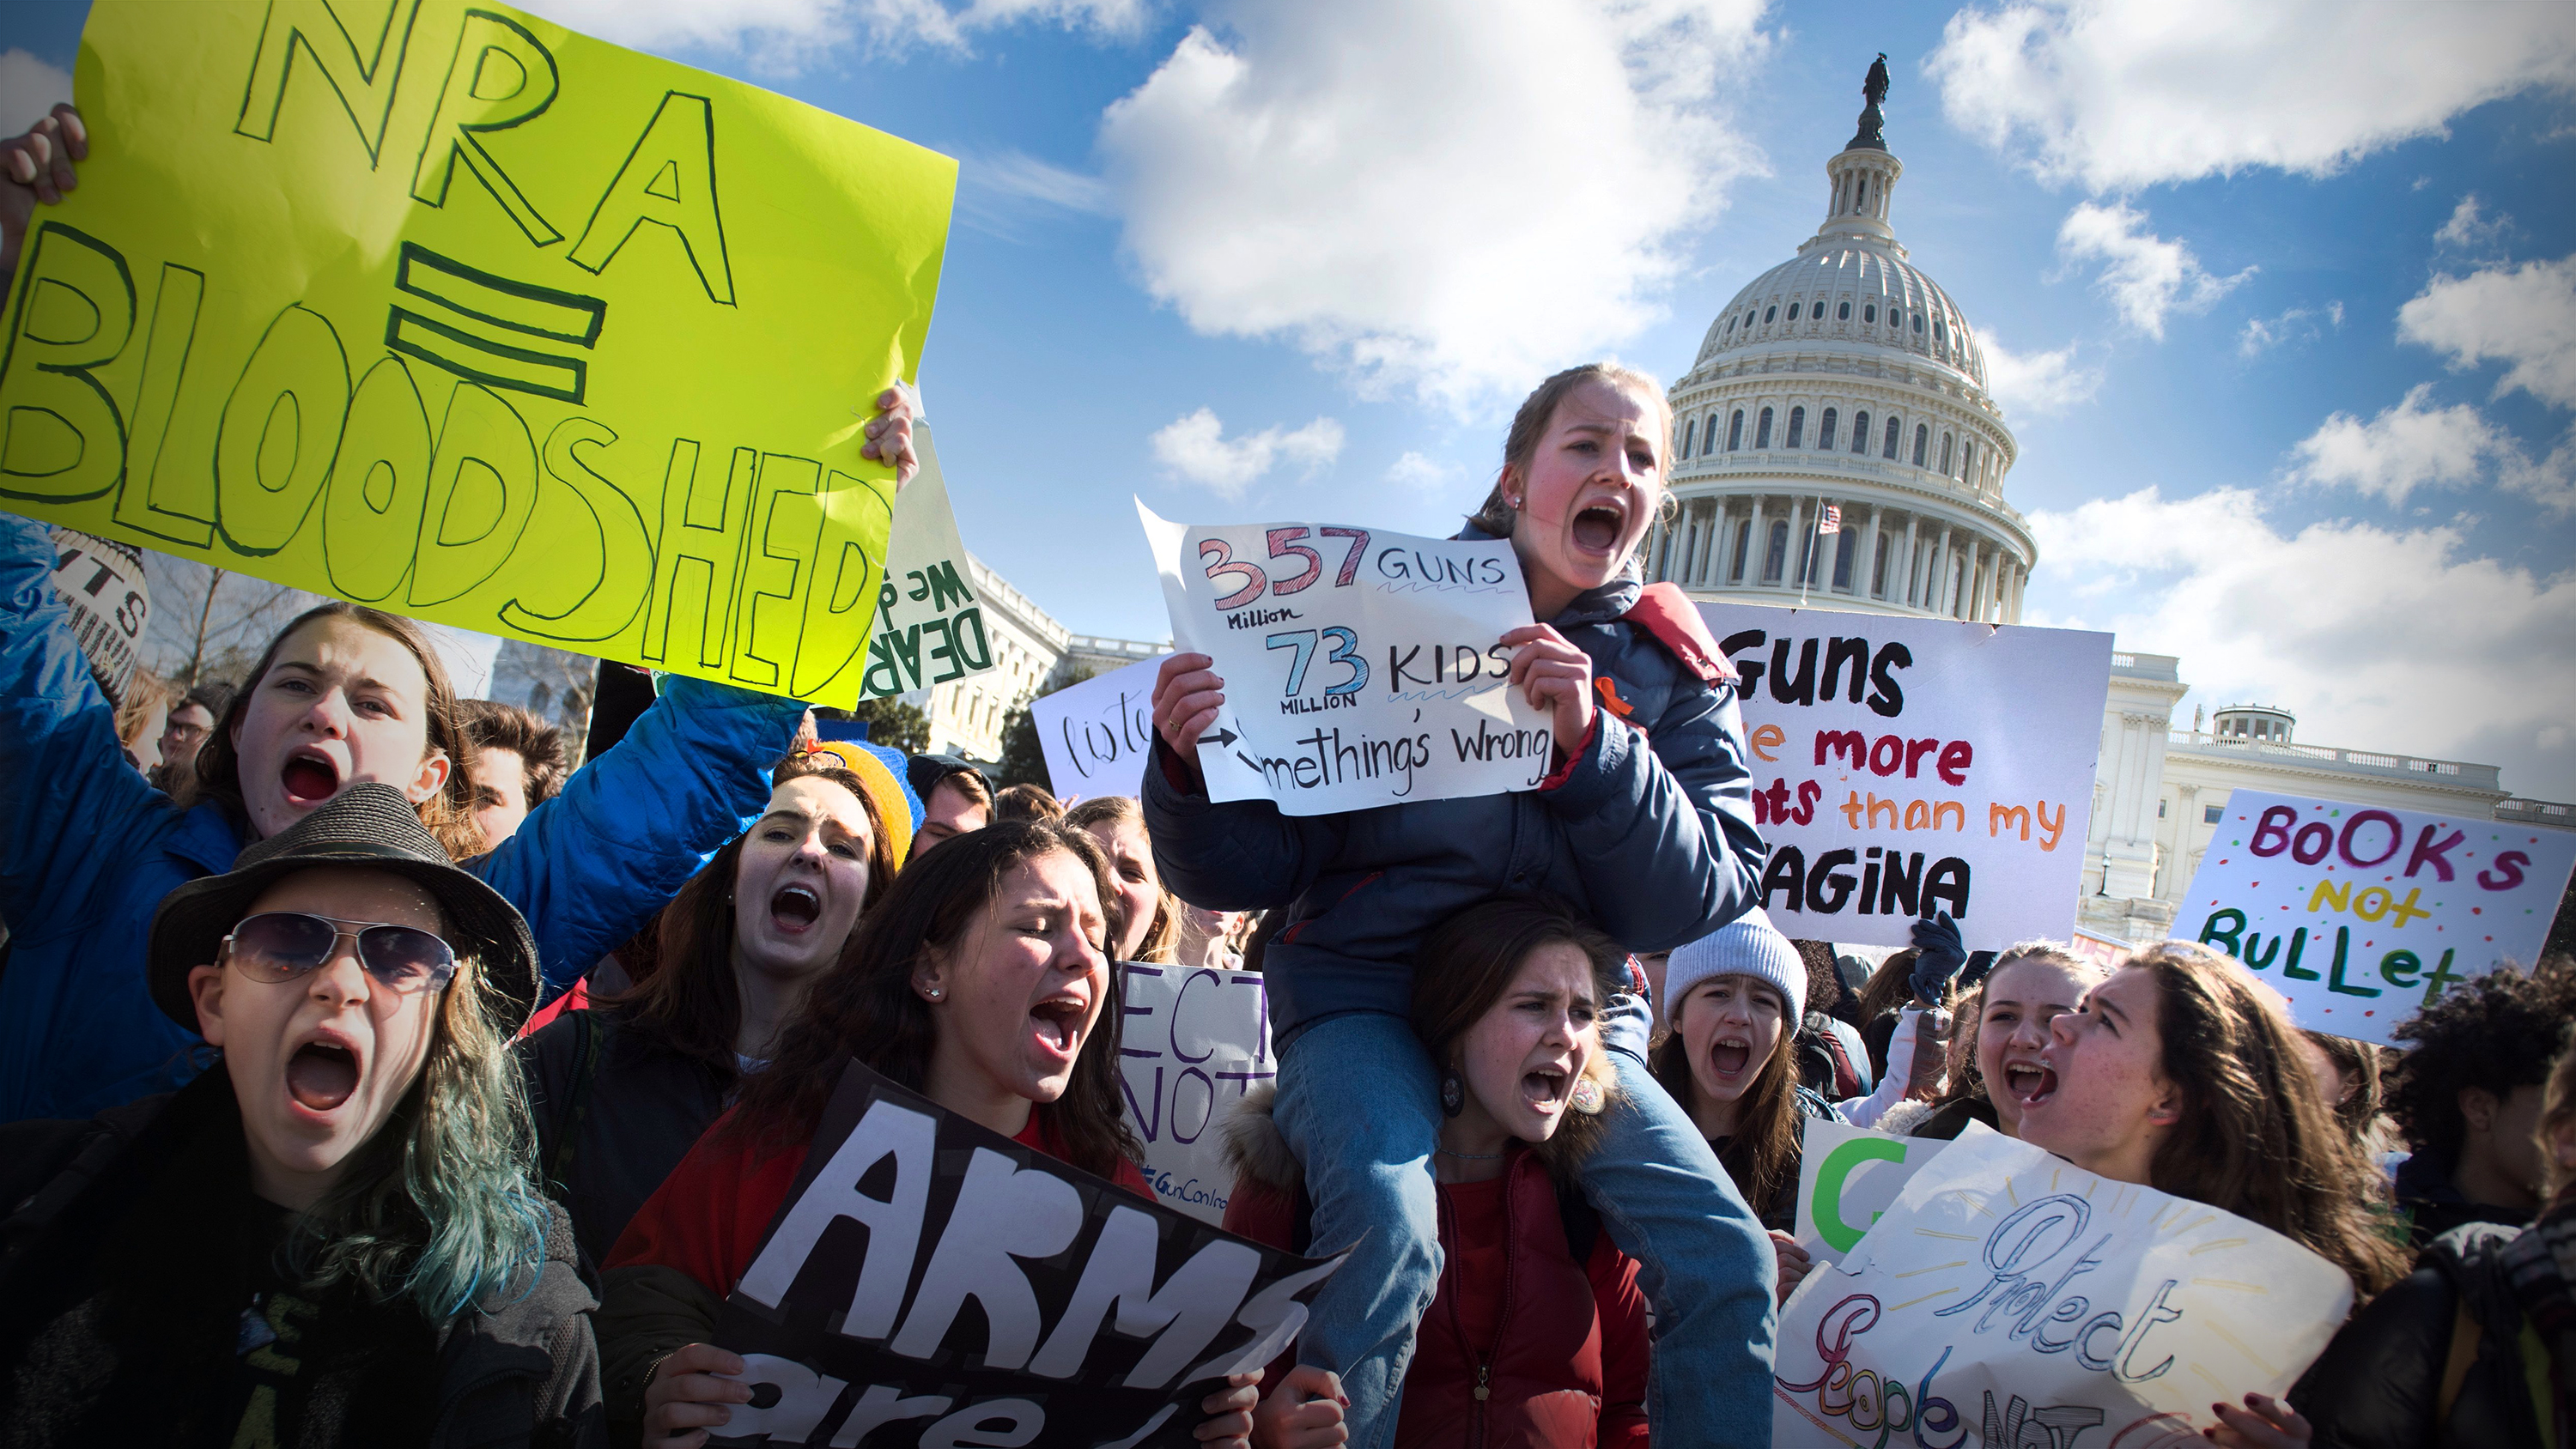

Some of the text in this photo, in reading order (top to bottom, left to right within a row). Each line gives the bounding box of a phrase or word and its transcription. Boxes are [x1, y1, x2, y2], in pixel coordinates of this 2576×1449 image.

[233, 0, 738, 309] NRA
[0, 220, 894, 697] BLOODSHED
[1198, 527, 1507, 611] 357 GUNS
[1266, 626, 1513, 697] 73 KIDS
[1062, 688, 1151, 779] liste
[1280, 693, 1358, 715] MILLION
[1814, 729, 1973, 787] more
[1839, 790, 1966, 832] than
[1989, 799, 2067, 852] my
[1934, 1193, 2183, 1384] Protect
